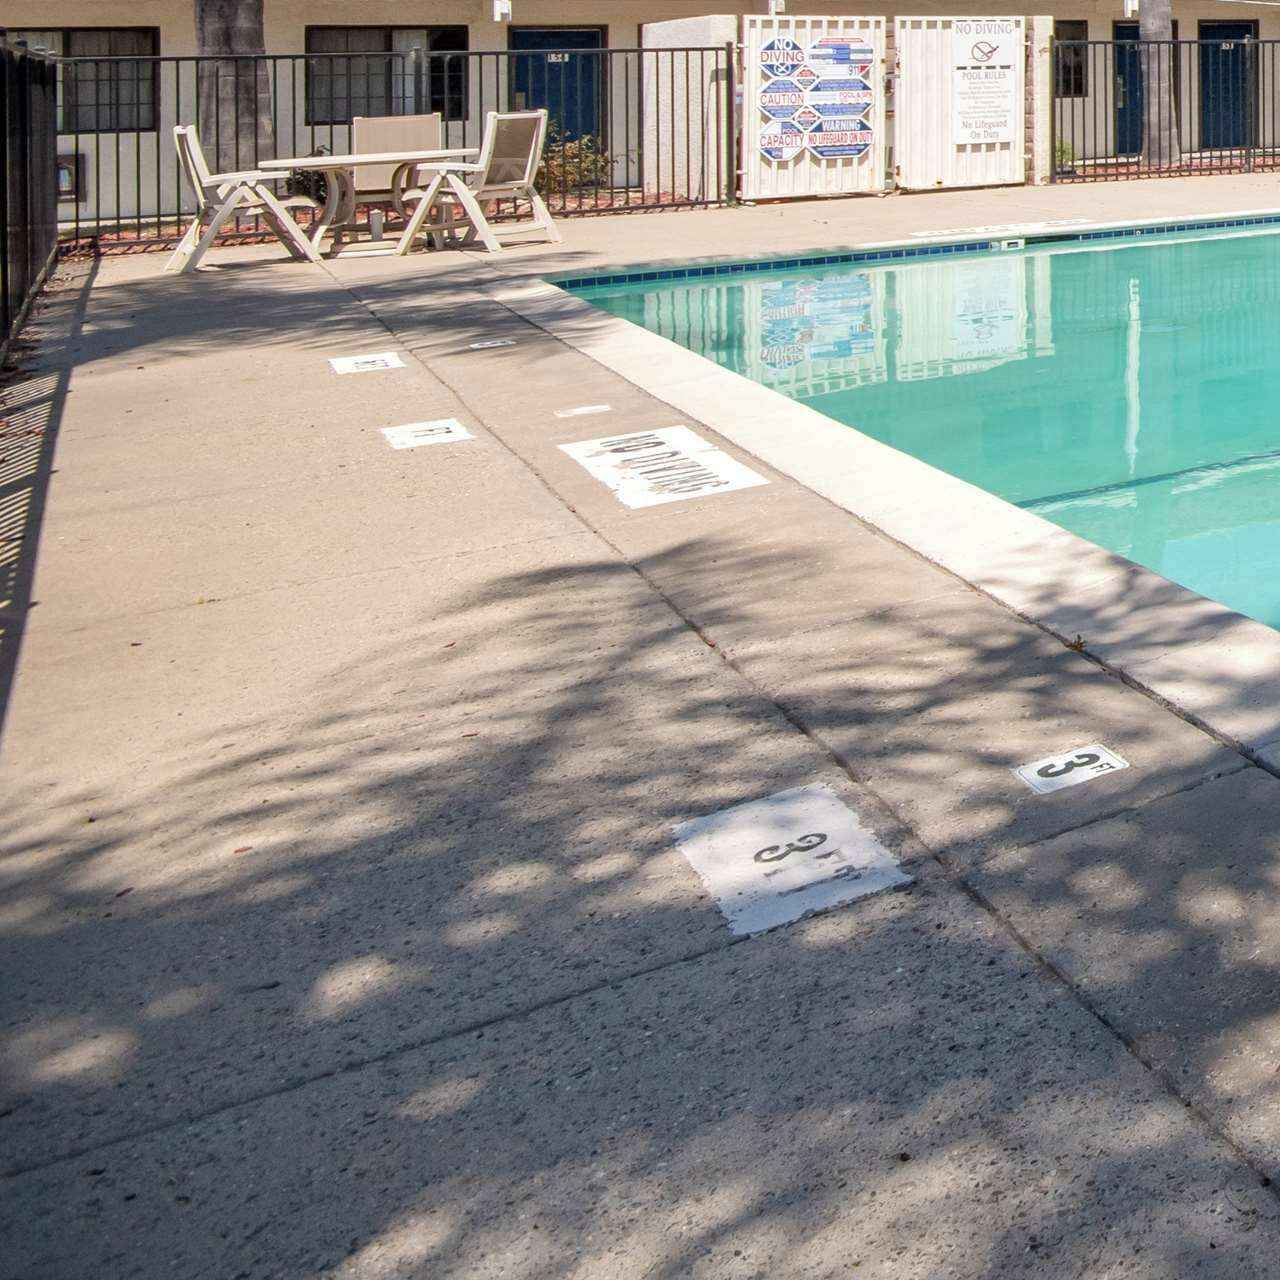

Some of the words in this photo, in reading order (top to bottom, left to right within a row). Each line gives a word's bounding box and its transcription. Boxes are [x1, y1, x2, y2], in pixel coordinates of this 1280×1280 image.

[956, 24, 971, 35] NO
[976, 23, 1012, 34] DIVING
[774, 39, 793, 50] NO
[760, 51, 804, 63] DIVING
[962, 71, 982, 80] POOL
[985, 71, 1007, 80] RULES
[760, 92, 804, 106] CAUTION
[821, 120, 860, 131] WARNING
[962, 120, 972, 129] No
[975, 120, 1008, 130] Lifeguard
[760, 134, 804, 147] CAPACITY
[808, 133, 817, 145] NO
[819, 132, 848, 144] LIFEGUARD
[600, 434, 666, 454] NO
[619, 450, 730, 495] DIVING
[1037, 753, 1100, 778] 3
[1090, 762, 1116, 773] FT
[753, 832, 828, 863] 3
